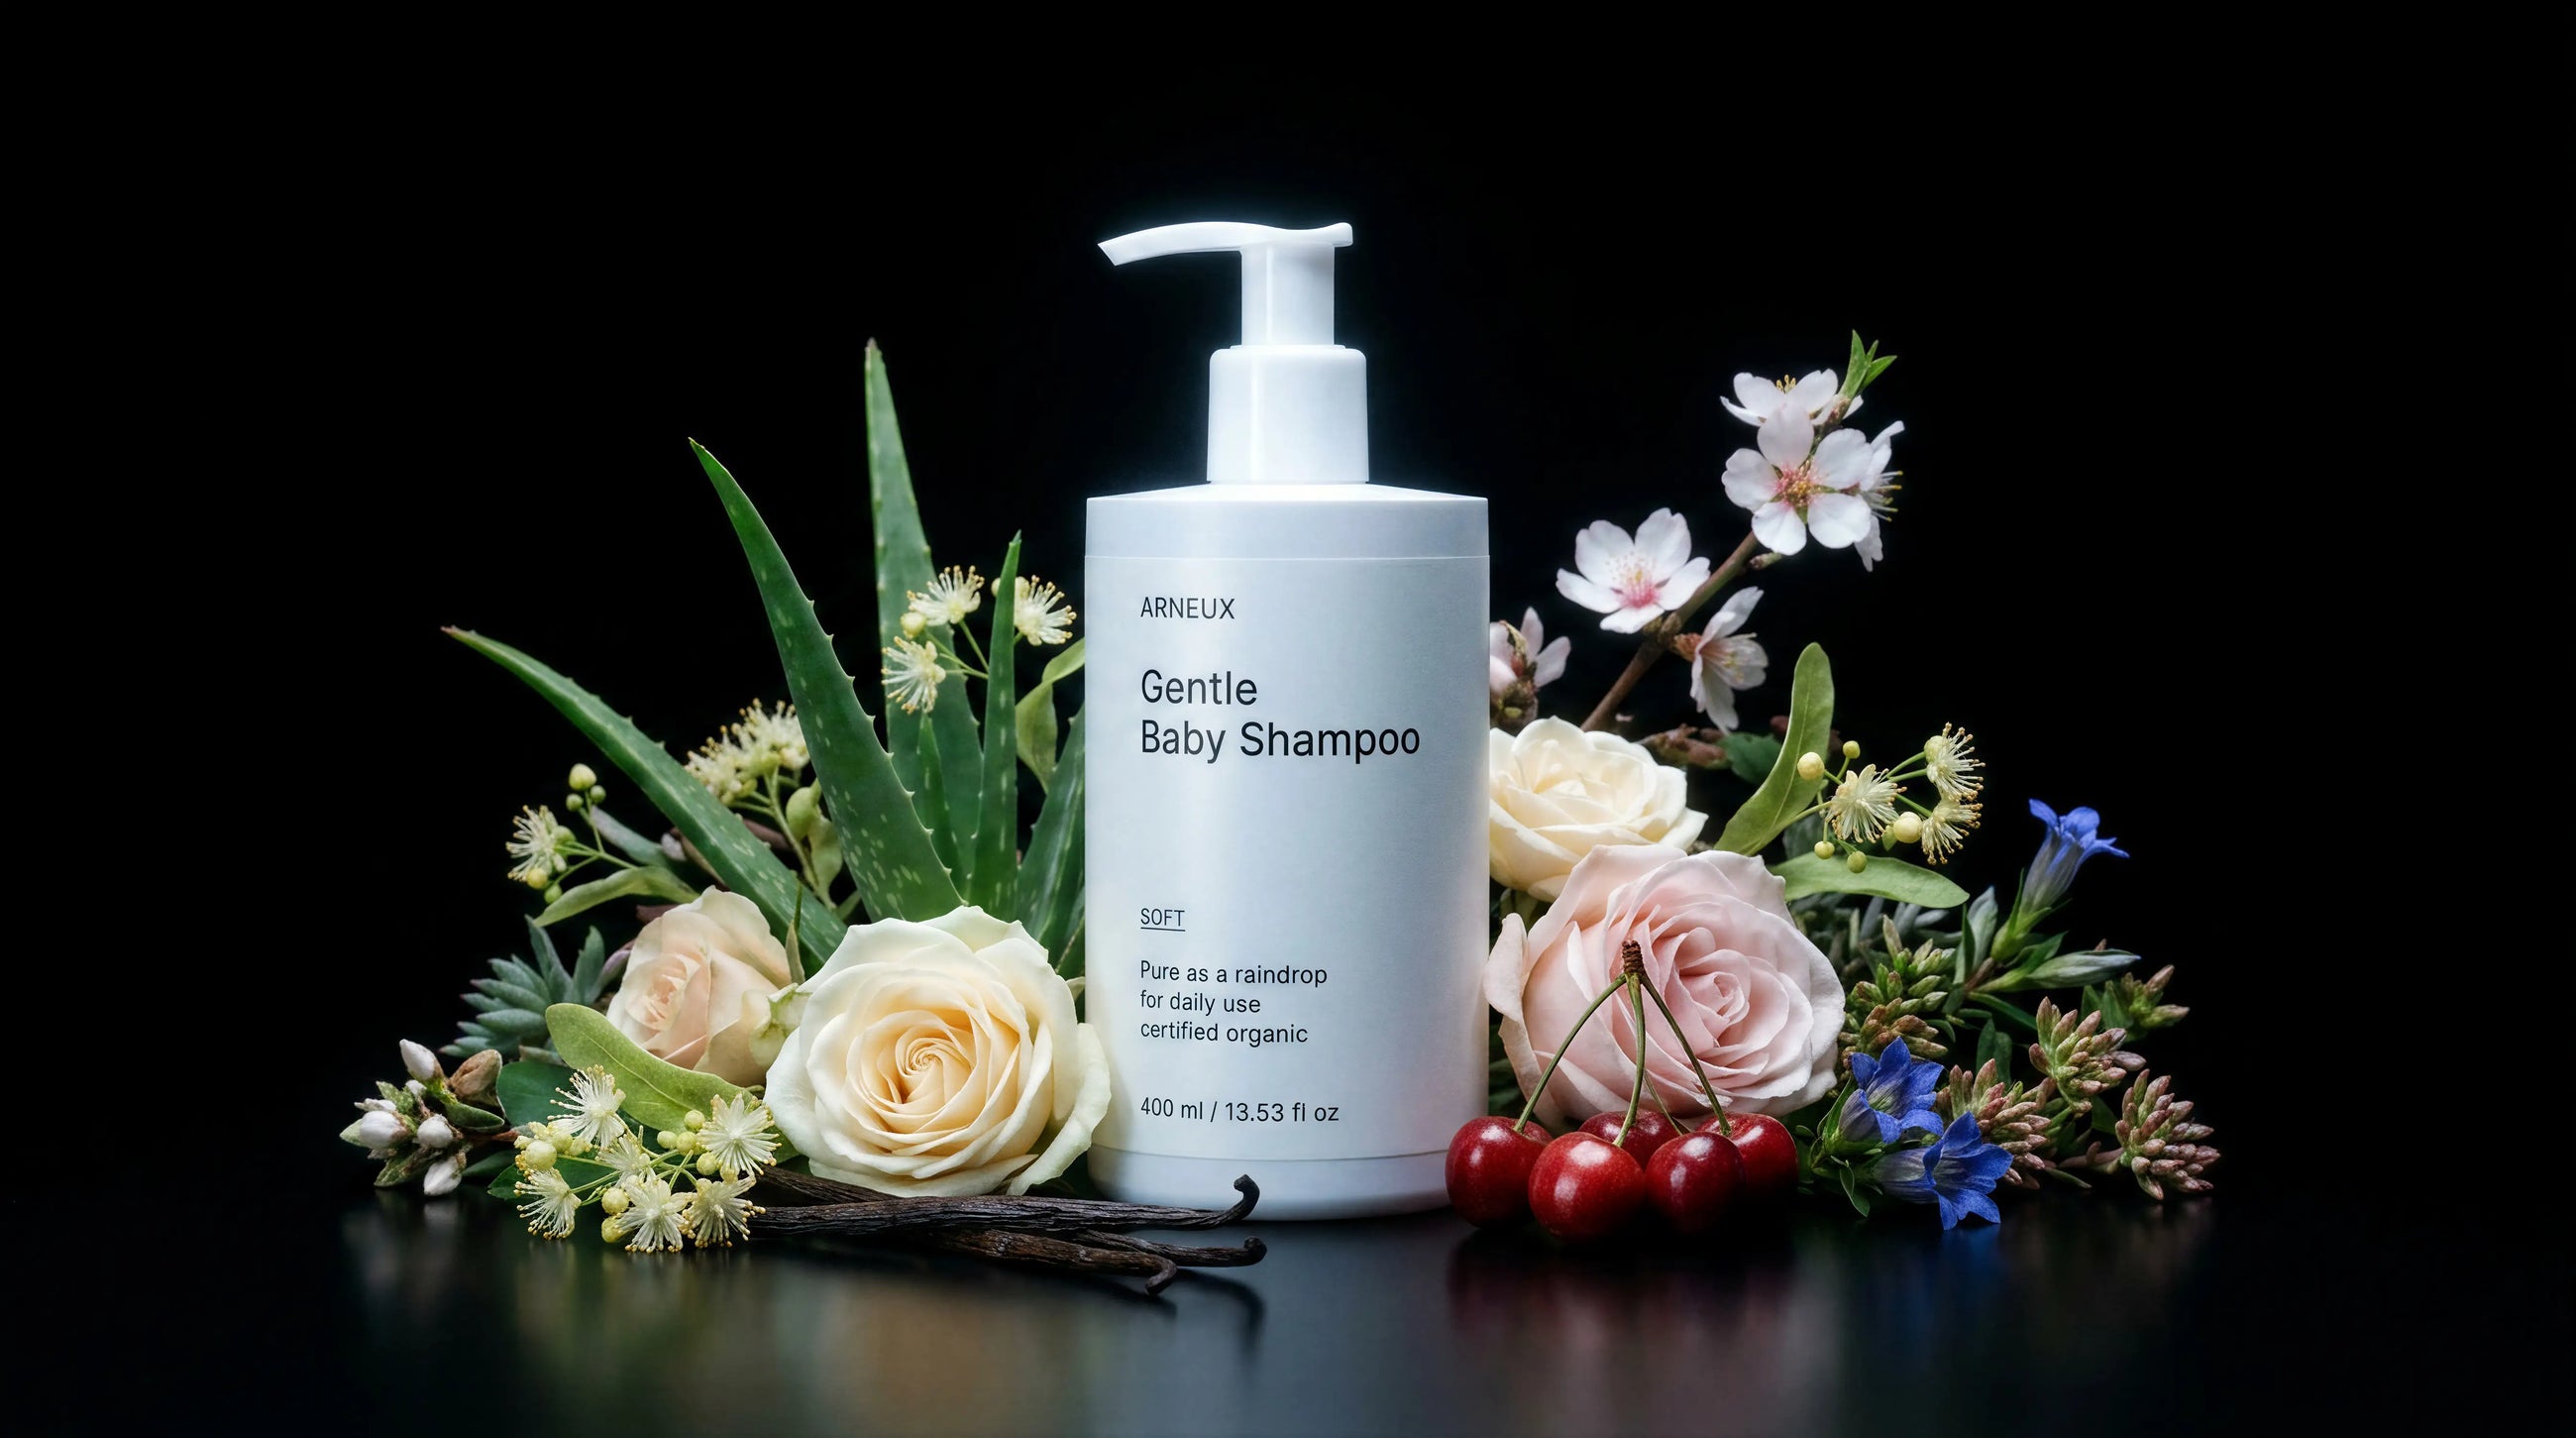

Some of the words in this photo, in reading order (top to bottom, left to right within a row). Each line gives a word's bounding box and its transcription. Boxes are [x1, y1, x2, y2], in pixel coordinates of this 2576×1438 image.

[1140, 597, 1235, 619] ARNEUX
[1141, 669, 1258, 706] Gentle
[1141, 719, 1227, 764] Baby
[1240, 721, 1421, 764] Shampoo
[1140, 908, 1185, 928] SOFT
[1140, 960, 1180, 981] Pure
[1187, 967, 1209, 983] as
[1216, 968, 1228, 983] a
[1235, 964, 1328, 988] raindrop
[1140, 989, 1163, 1009] for
[1170, 992, 1216, 1016] daily
[1224, 998, 1261, 1013] use
[1140, 1020, 1219, 1042] certified
[1227, 1024, 1309, 1049] organic
[1140, 1097, 1174, 1118] 400
[1181, 1100, 1203, 1120] ml
[1210, 1100, 1218, 1123] /
[1226, 1102, 1284, 1122] 13.53
[1292, 1102, 1306, 1122] fl
[1315, 1107, 1340, 1122] oz
